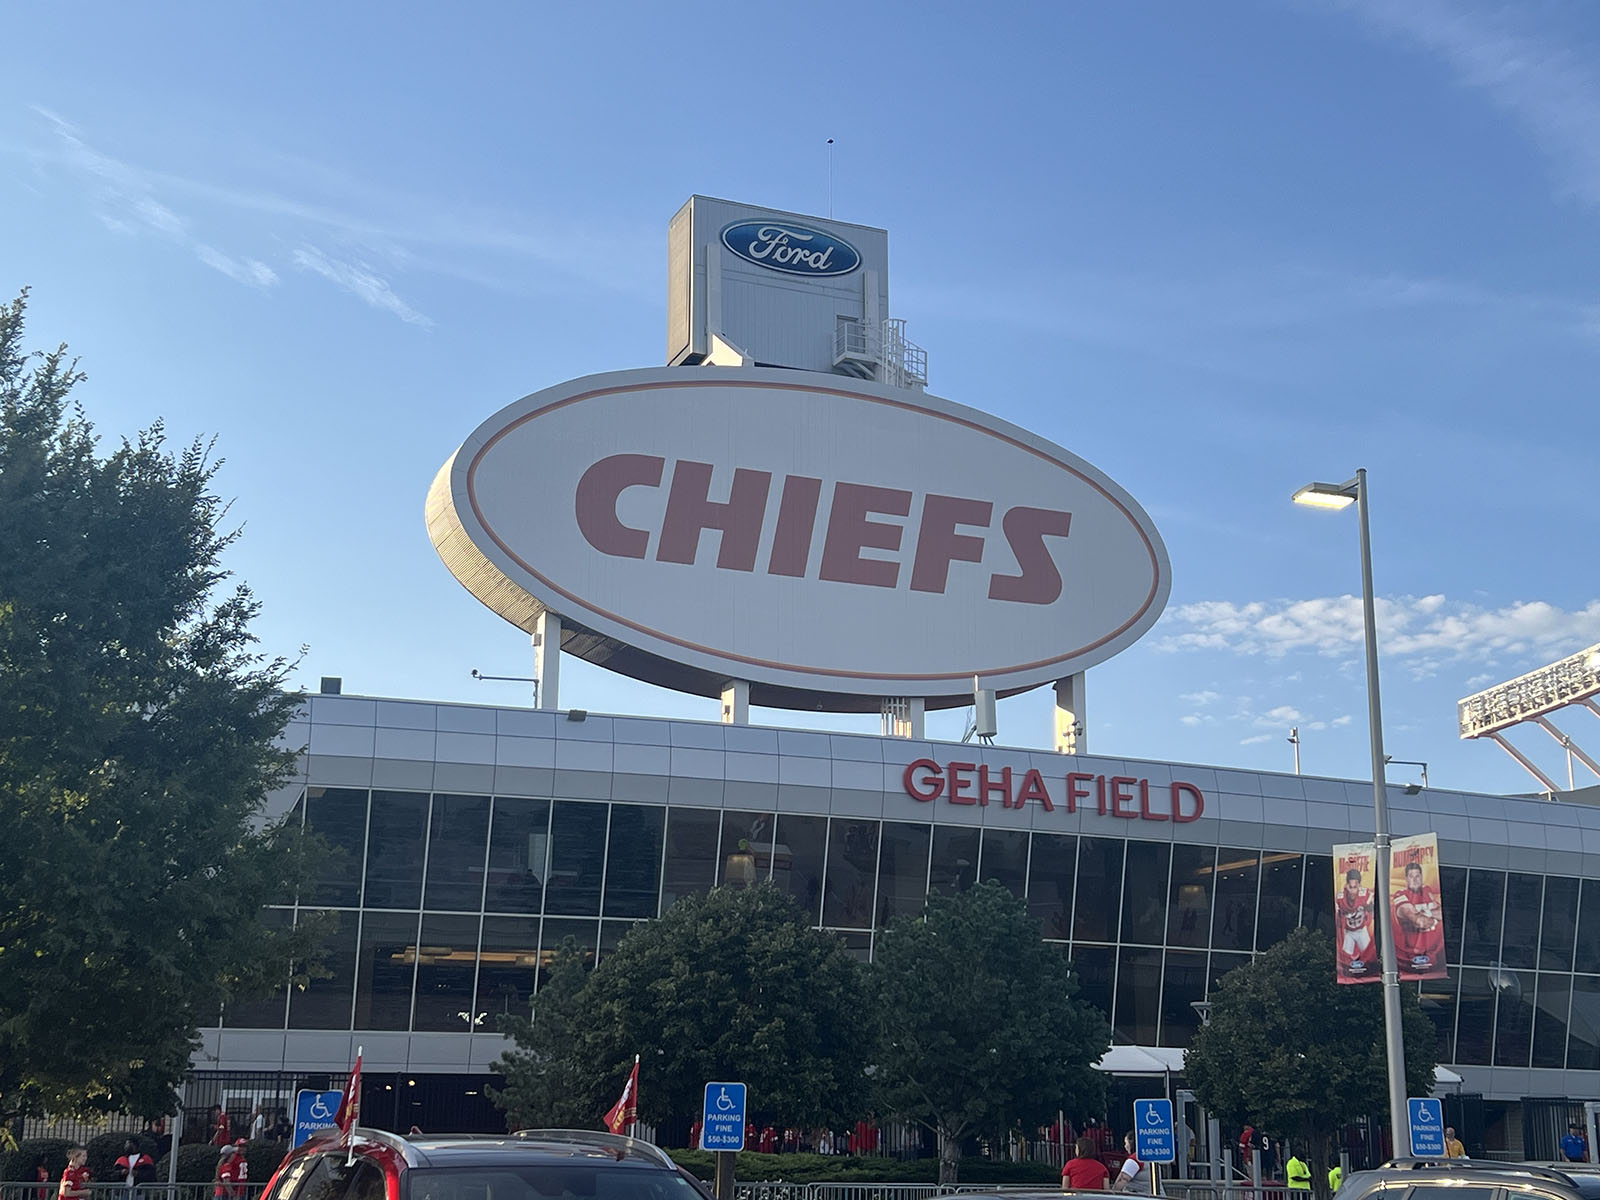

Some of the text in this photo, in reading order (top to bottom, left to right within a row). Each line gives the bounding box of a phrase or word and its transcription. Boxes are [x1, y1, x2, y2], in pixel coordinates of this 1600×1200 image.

[748, 226, 835, 270] Ford
[575, 453, 1072, 605] CHIEFS
[903, 758, 1205, 824] GEHA FIELD
[707, 1113, 741, 1122] PARKING
[1413, 1124, 1440, 1132] PARKING
[707, 1135, 740, 1144] $50-$300
[1262, 1136, 1269, 1150] 9
[1141, 1148, 1171, 1156] $50-$300
